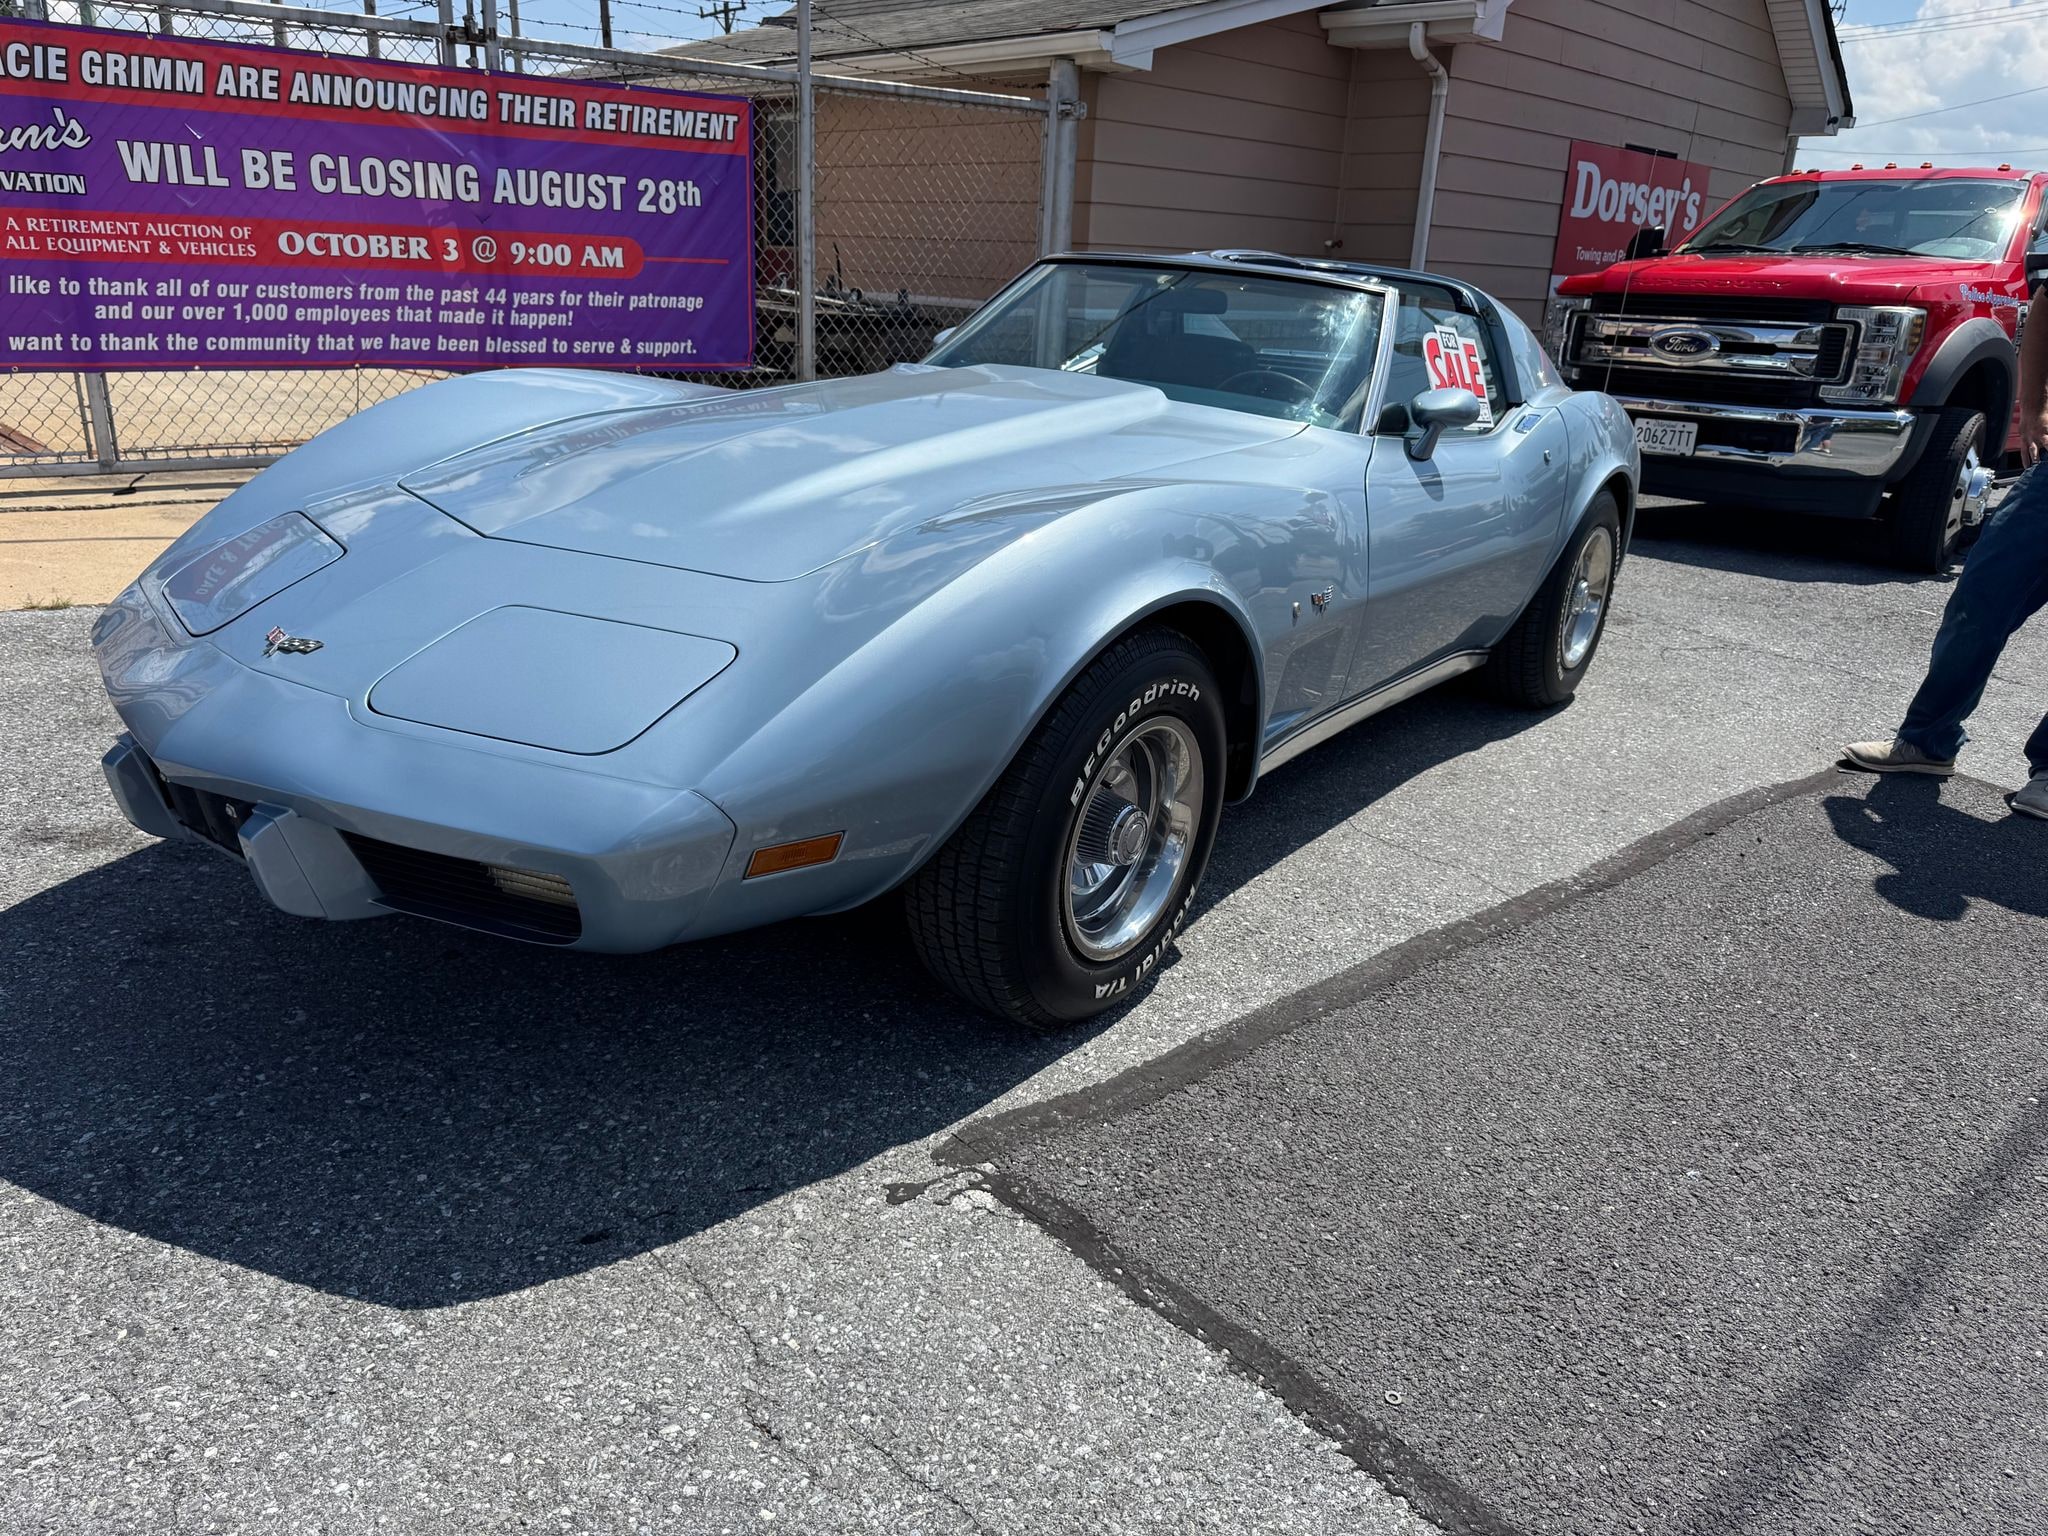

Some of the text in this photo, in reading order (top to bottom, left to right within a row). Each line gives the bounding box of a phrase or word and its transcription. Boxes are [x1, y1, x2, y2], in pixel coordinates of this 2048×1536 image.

[0, 42, 738, 141] CIE GRIMM ARE ANNOUNCING THEIR RETIREMENT
[116, 140, 701, 214] WILL BE CLOSING AUGUST 28th
[1570, 160, 1701, 240] Dorsey's
[6, 217, 252, 241] A RETIREMENT AUCTION OF
[6, 236, 257, 258] ALL EQUIPMENT & VEHICLES
[277, 231, 625, 269] OCTOBER 3 @ 9:00 AM
[1576, 246, 1601, 265] Towing
[1602, 249, 1617, 263] and
[10, 275, 704, 310] like to thank all of our customers from the past 44 years for their patronage
[95, 303, 574, 330] and our over 1,000 employees that made it happen!
[9, 333, 697, 356] want to thank the community that we have been blessed to serve & support.
[1441, 333, 1458, 350] FOR
[1664, 336, 1697, 353] Ford
[1426, 338, 1486, 398] SALE
